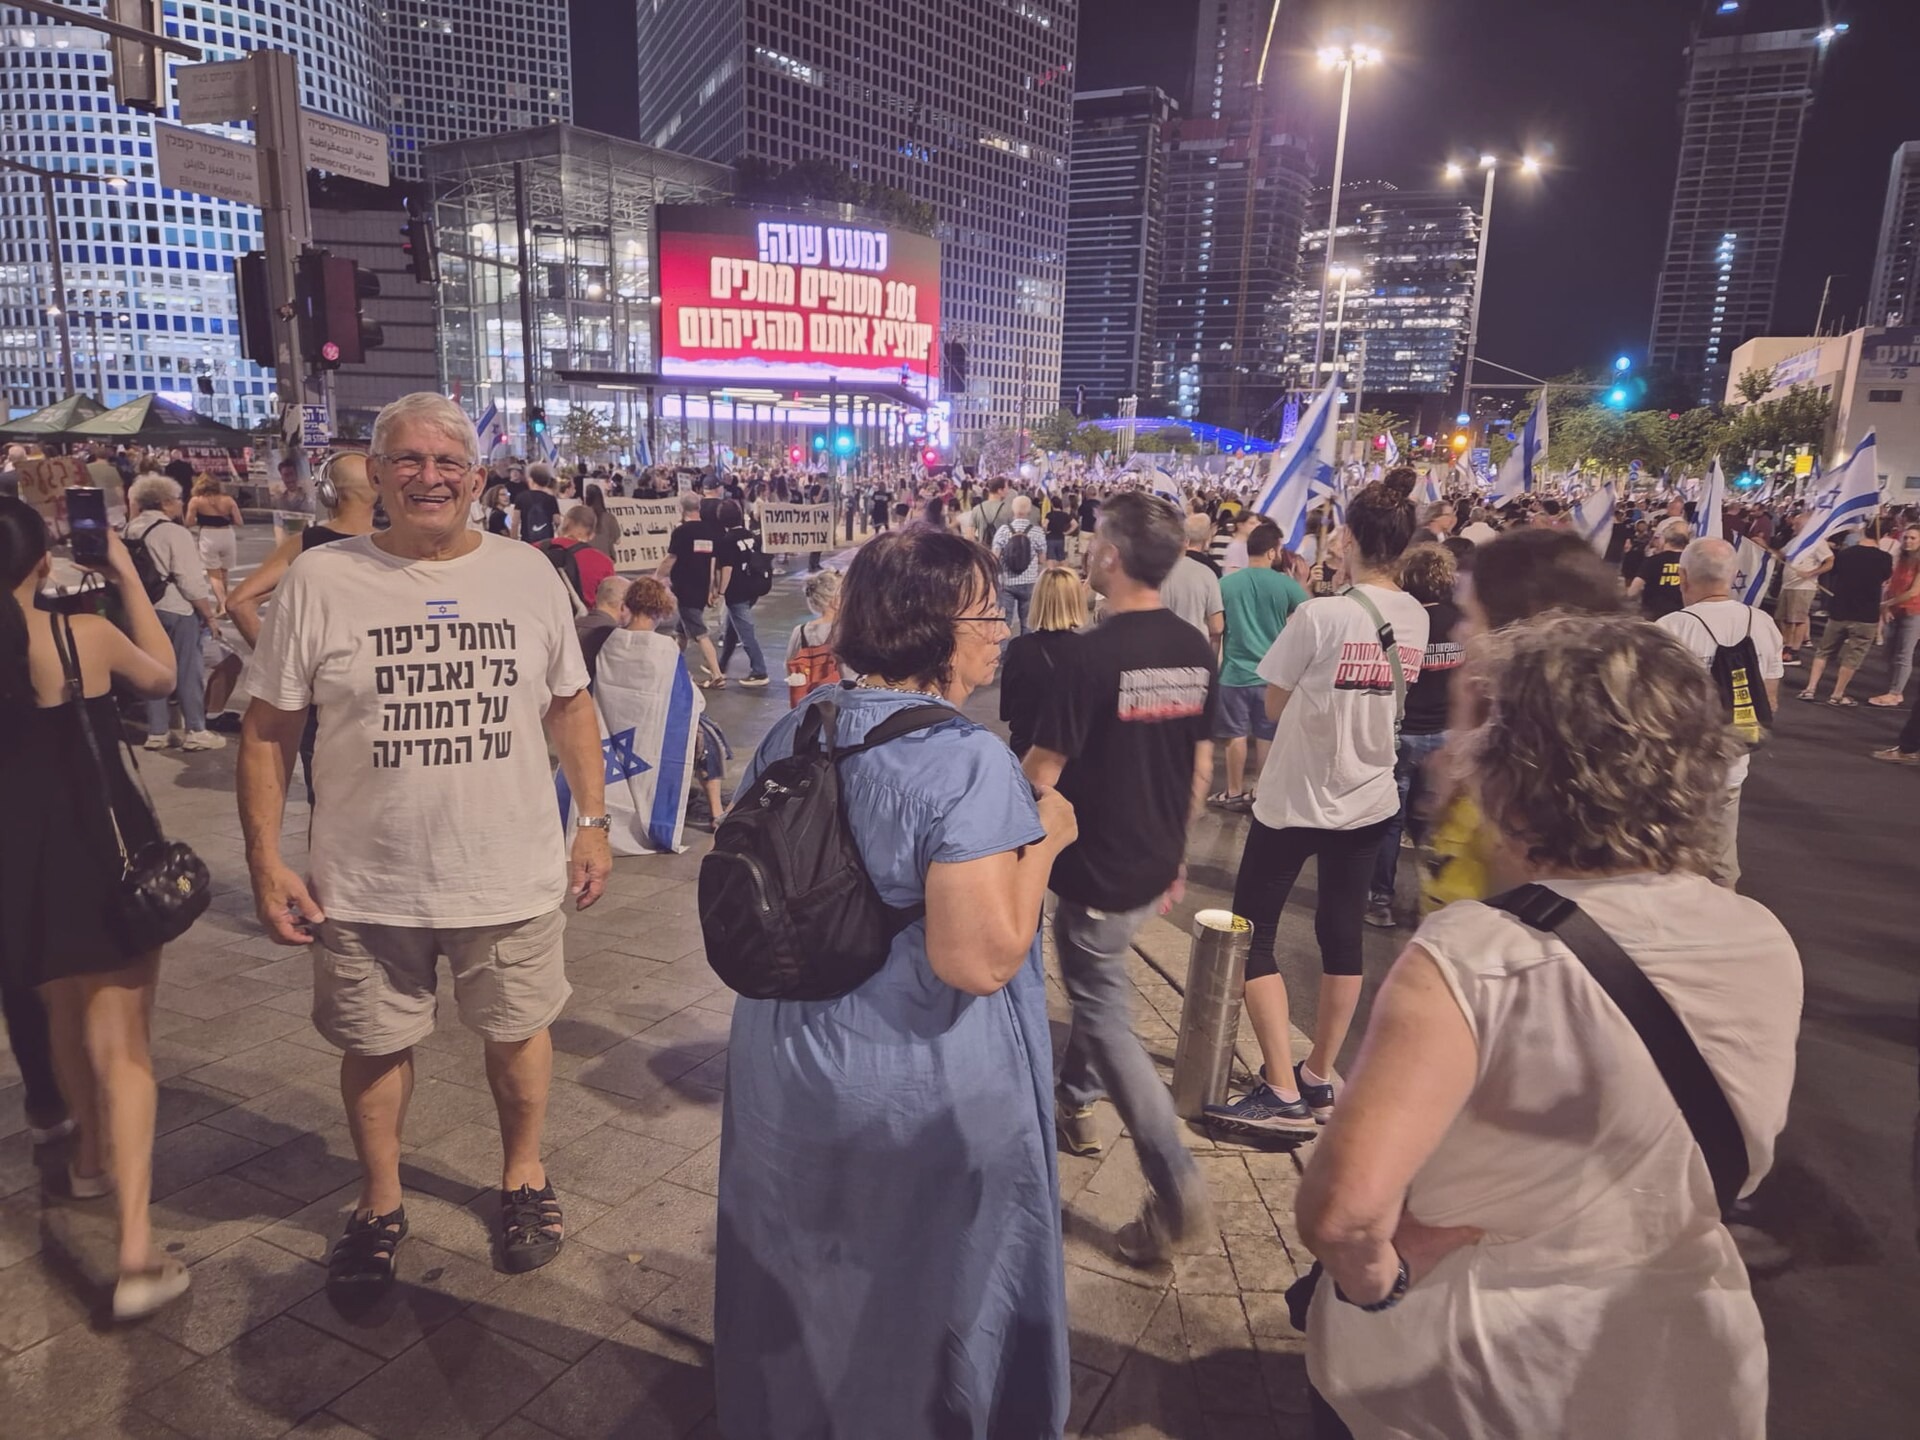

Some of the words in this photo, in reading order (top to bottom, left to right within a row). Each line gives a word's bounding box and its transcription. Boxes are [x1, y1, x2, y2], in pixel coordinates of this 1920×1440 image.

[165, 133, 194, 152] קפלן
[308, 118, 361, 141] הדמוקרטיה
[195, 141, 235, 160] אליעזר
[309, 152, 352, 174] Democracy
[758, 222, 822, 265] שנה!
[827, 226, 888, 271] כמעט
[710, 256, 796, 305] מחכים
[800, 267, 883, 319] חטופים
[885, 280, 917, 322] 101
[678, 306, 804, 352] מהגיהנום
[809, 312, 869, 355] אותם
[1890, 367, 1909, 379] 75
[636, 504, 663, 515] מעגל
[664, 505, 676, 514] את
[765, 509, 810, 523] מלחמה
[813, 510, 830, 525] אין
[616, 548, 637, 563] TOP
[641, 546, 659, 560] THE
[792, 531, 828, 546] צודקת
[367, 623, 441, 657] כיפור
[447, 618, 516, 651] לוחמי
[375, 661, 475, 697] נאבקים
[382, 699, 471, 732] דמותה
[477, 691, 509, 724] על
[373, 735, 472, 768] המדינה
[479, 728, 512, 761] של
